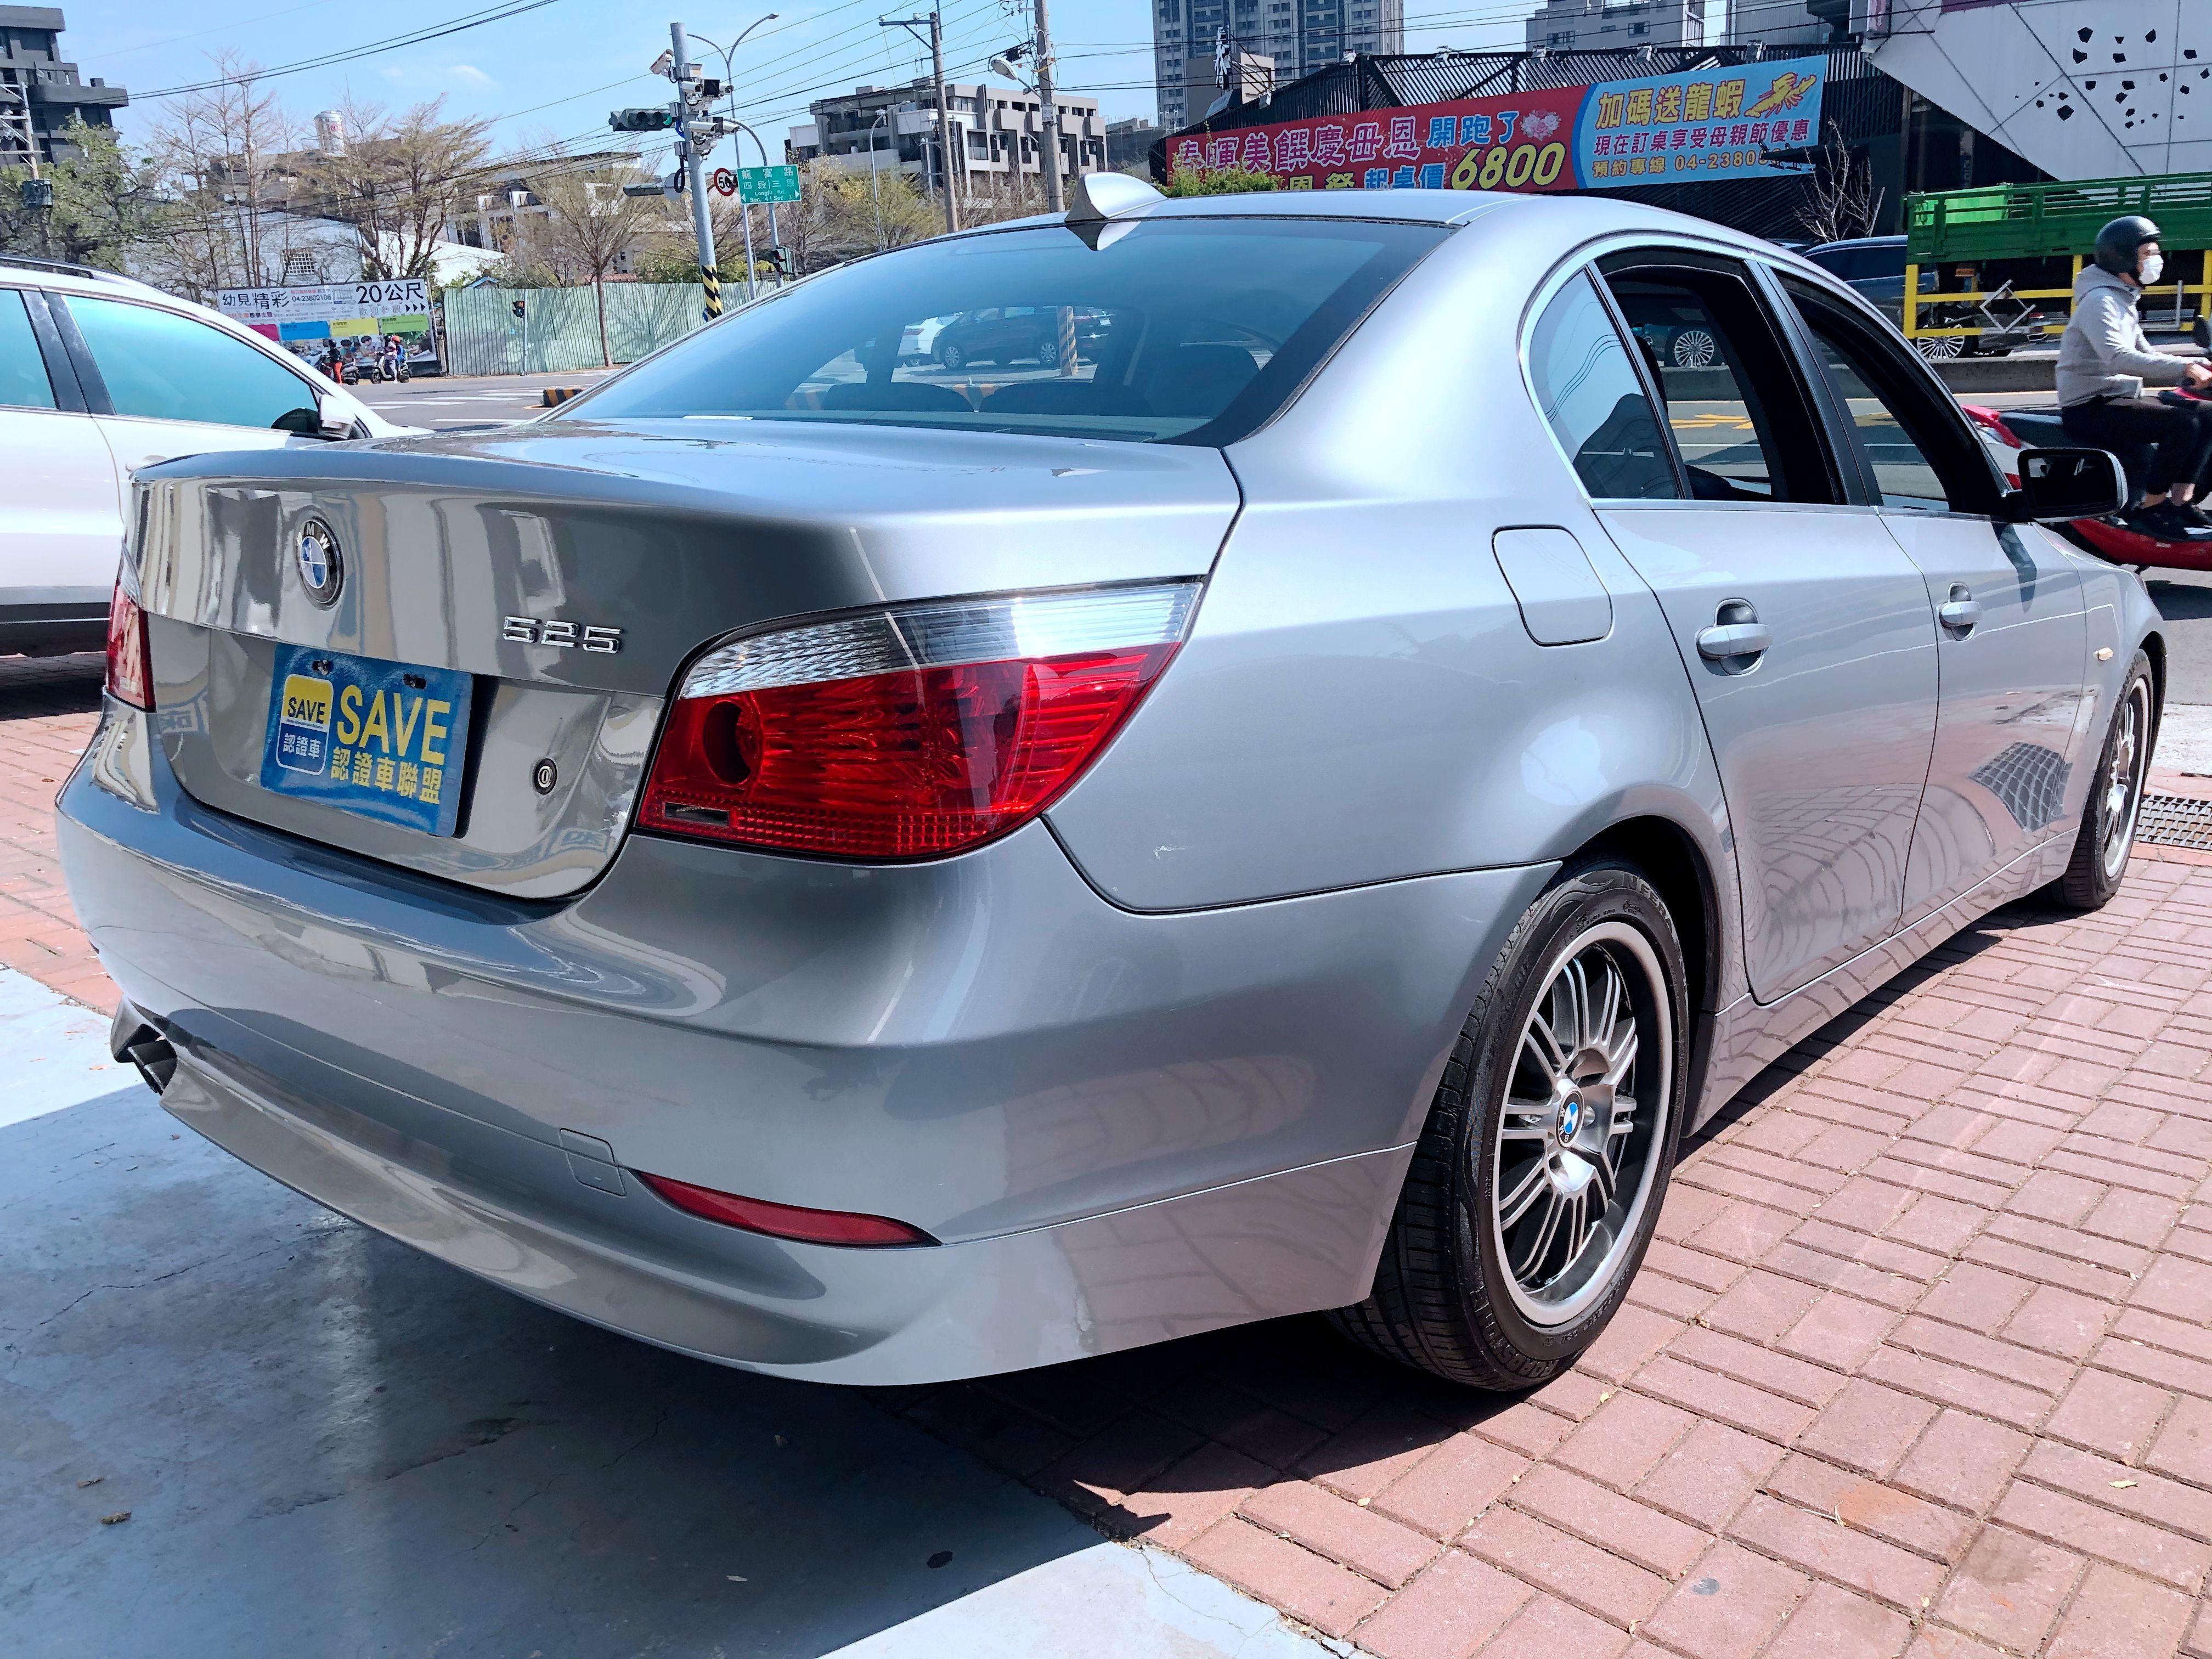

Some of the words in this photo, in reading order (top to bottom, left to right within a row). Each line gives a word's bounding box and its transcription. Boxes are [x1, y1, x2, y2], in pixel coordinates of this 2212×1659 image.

[1595, 79, 1745, 129] 加碼送龍蝦
[1426, 110, 1520, 149] 開跑了
[1593, 119, 1810, 156] 現在訂桌享受母親節優惠
[741, 167, 793, 179] 龍富路
[743, 180, 766, 189] 四段
[772, 178, 794, 188] 三段
[1451, 142, 1566, 190] 6800
[1592, 156, 1666, 178] 預約專線
[356, 282, 424, 304] 20公尺
[502, 616, 623, 654] 525
[287, 696, 326, 724] SAVE
[337, 685, 450, 765] SAVE
[283, 733, 321, 759] 認證車
[330, 746, 442, 804] 認證車聯盟
[1559, 1107, 1570, 1142] BMW
